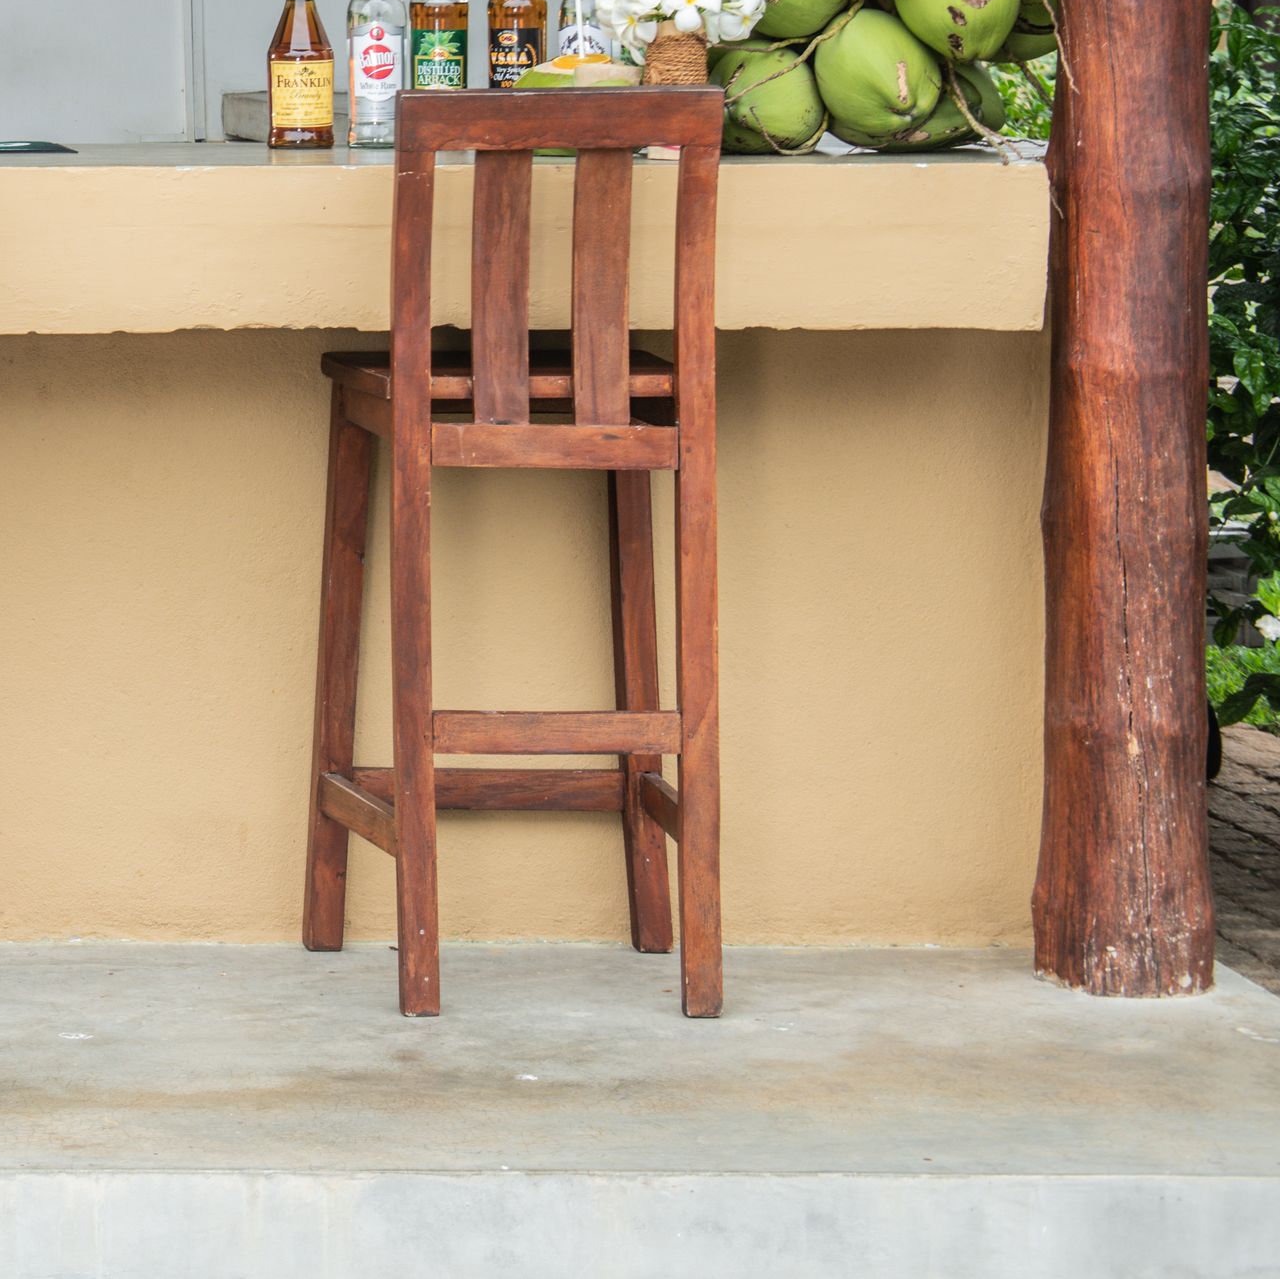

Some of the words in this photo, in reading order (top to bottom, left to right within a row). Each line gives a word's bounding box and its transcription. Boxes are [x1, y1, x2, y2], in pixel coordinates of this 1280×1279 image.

[417, 65, 461, 76] DISTILLED
[276, 74, 331, 88] FRANKLIN
[418, 75, 460, 85] ARRACK
[380, 81, 397, 90] Rum
